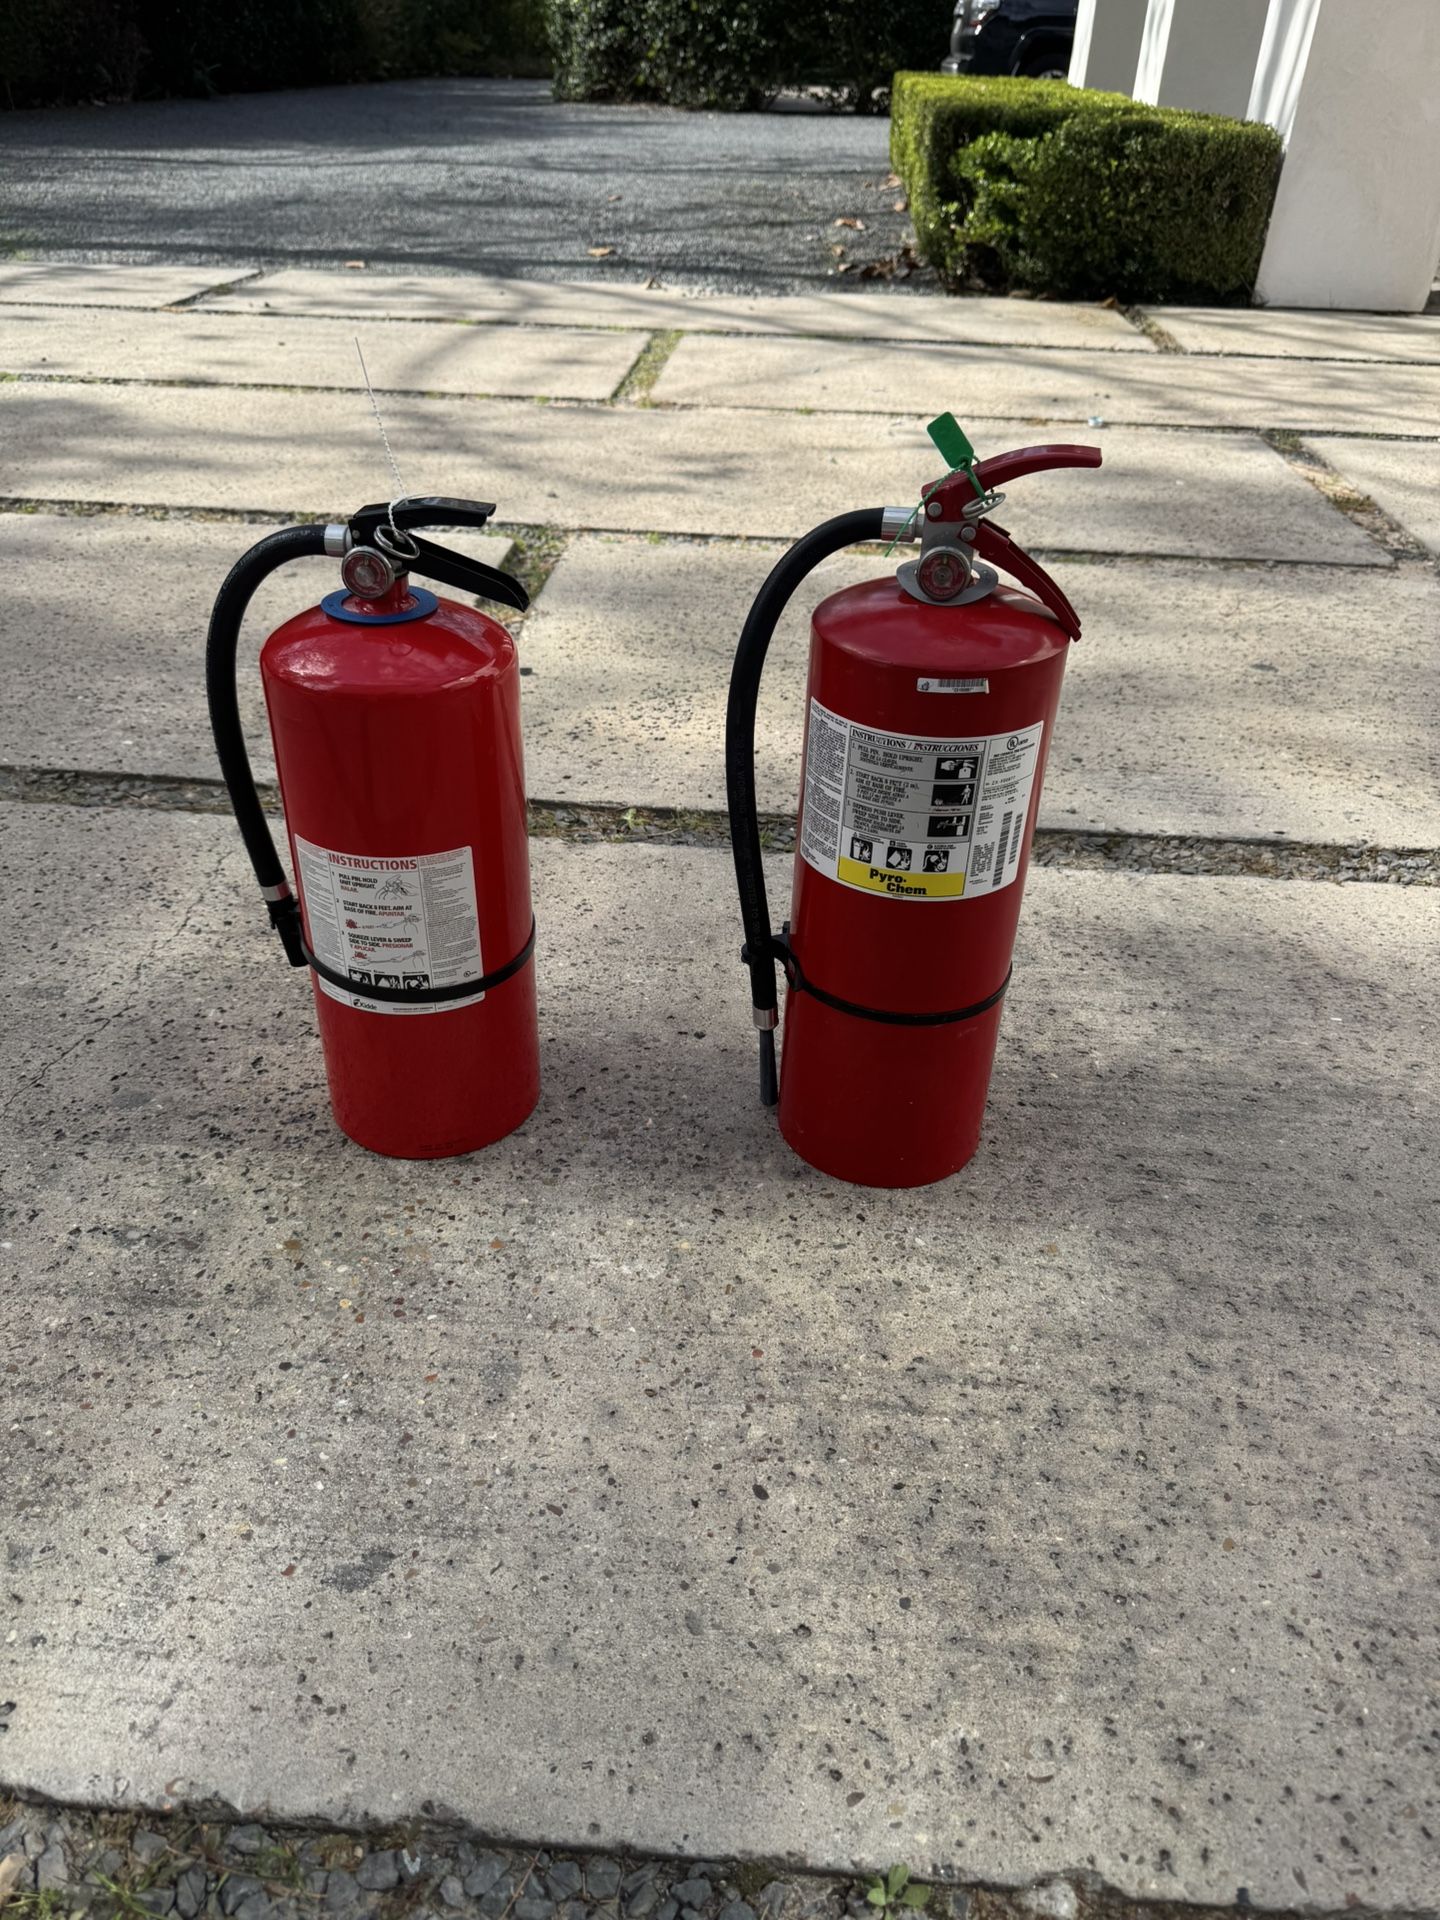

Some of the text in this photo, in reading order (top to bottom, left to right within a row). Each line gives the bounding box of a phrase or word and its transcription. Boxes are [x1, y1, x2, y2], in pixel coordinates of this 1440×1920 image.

[852, 729, 906, 748] INSTRUCTIONS
[913, 742, 979, 752] INSTRUCCIONES
[328, 853, 417, 870] INSTRUCTIONS
[886, 882, 928, 895] Chem
